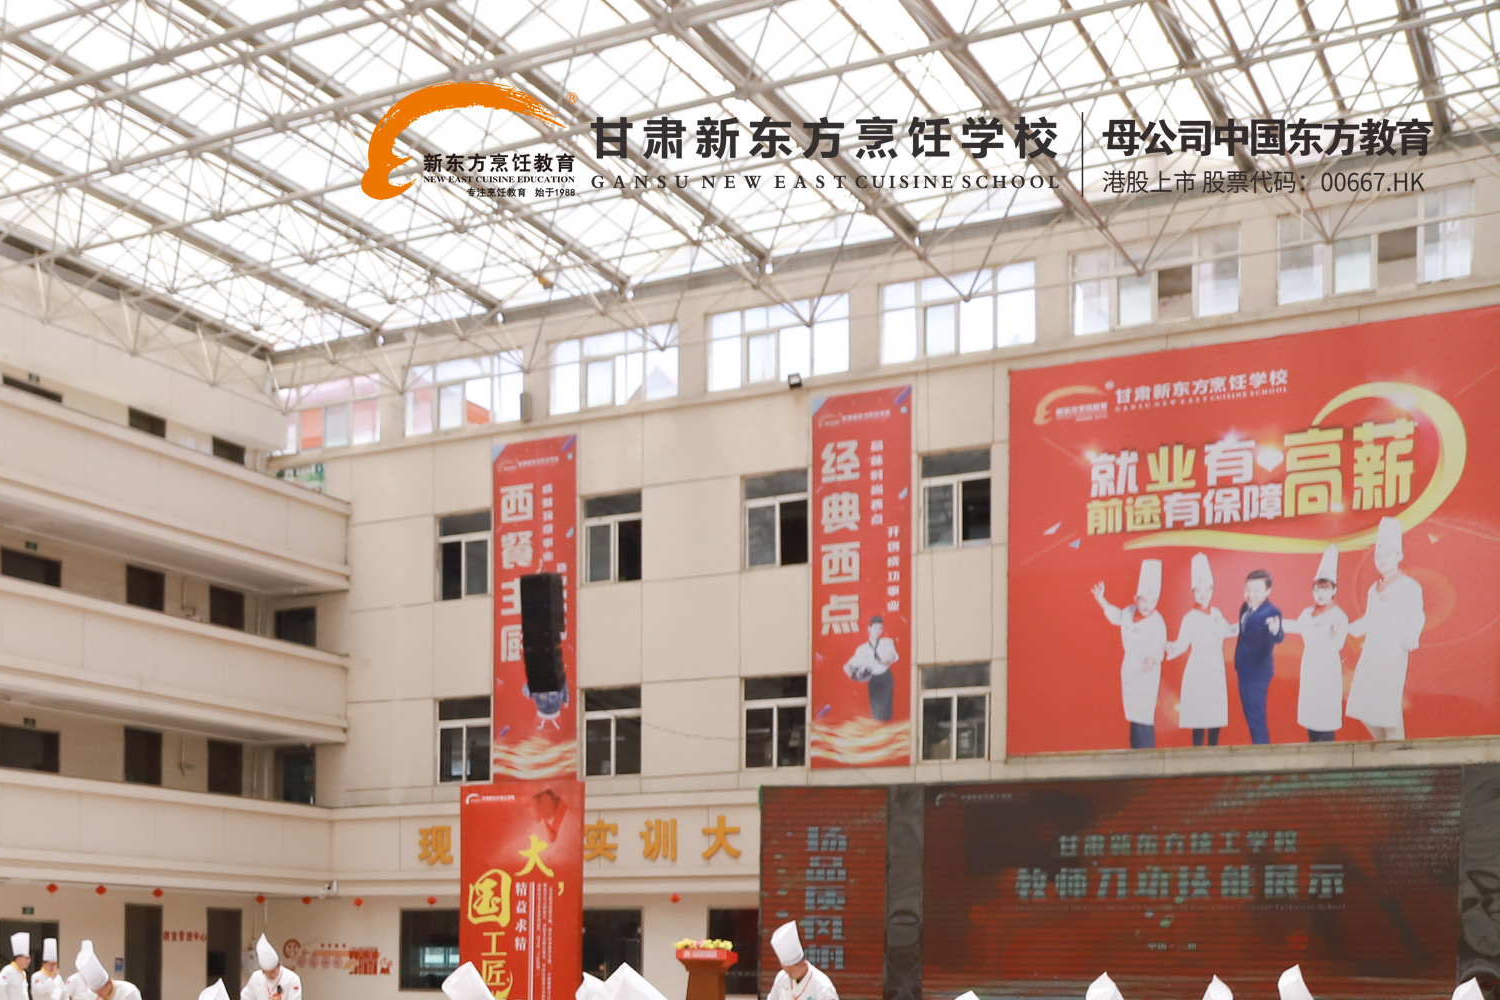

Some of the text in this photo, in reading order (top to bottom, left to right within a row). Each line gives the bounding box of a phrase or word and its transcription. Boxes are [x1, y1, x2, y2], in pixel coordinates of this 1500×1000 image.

[1115, 368, 1288, 405] 甘肃新东方烹饪学校
[1283, 418, 1417, 520] 高薪
[821, 438, 861, 636] 经典西点
[1086, 482, 1285, 537] 前途有保障
[499, 482, 534, 663] 西餐主厨
[418, 825, 455, 866] 现
[1014, 864, 1345, 900] 教师刀功技能展示
[514, 881, 528, 952] 精益求精
